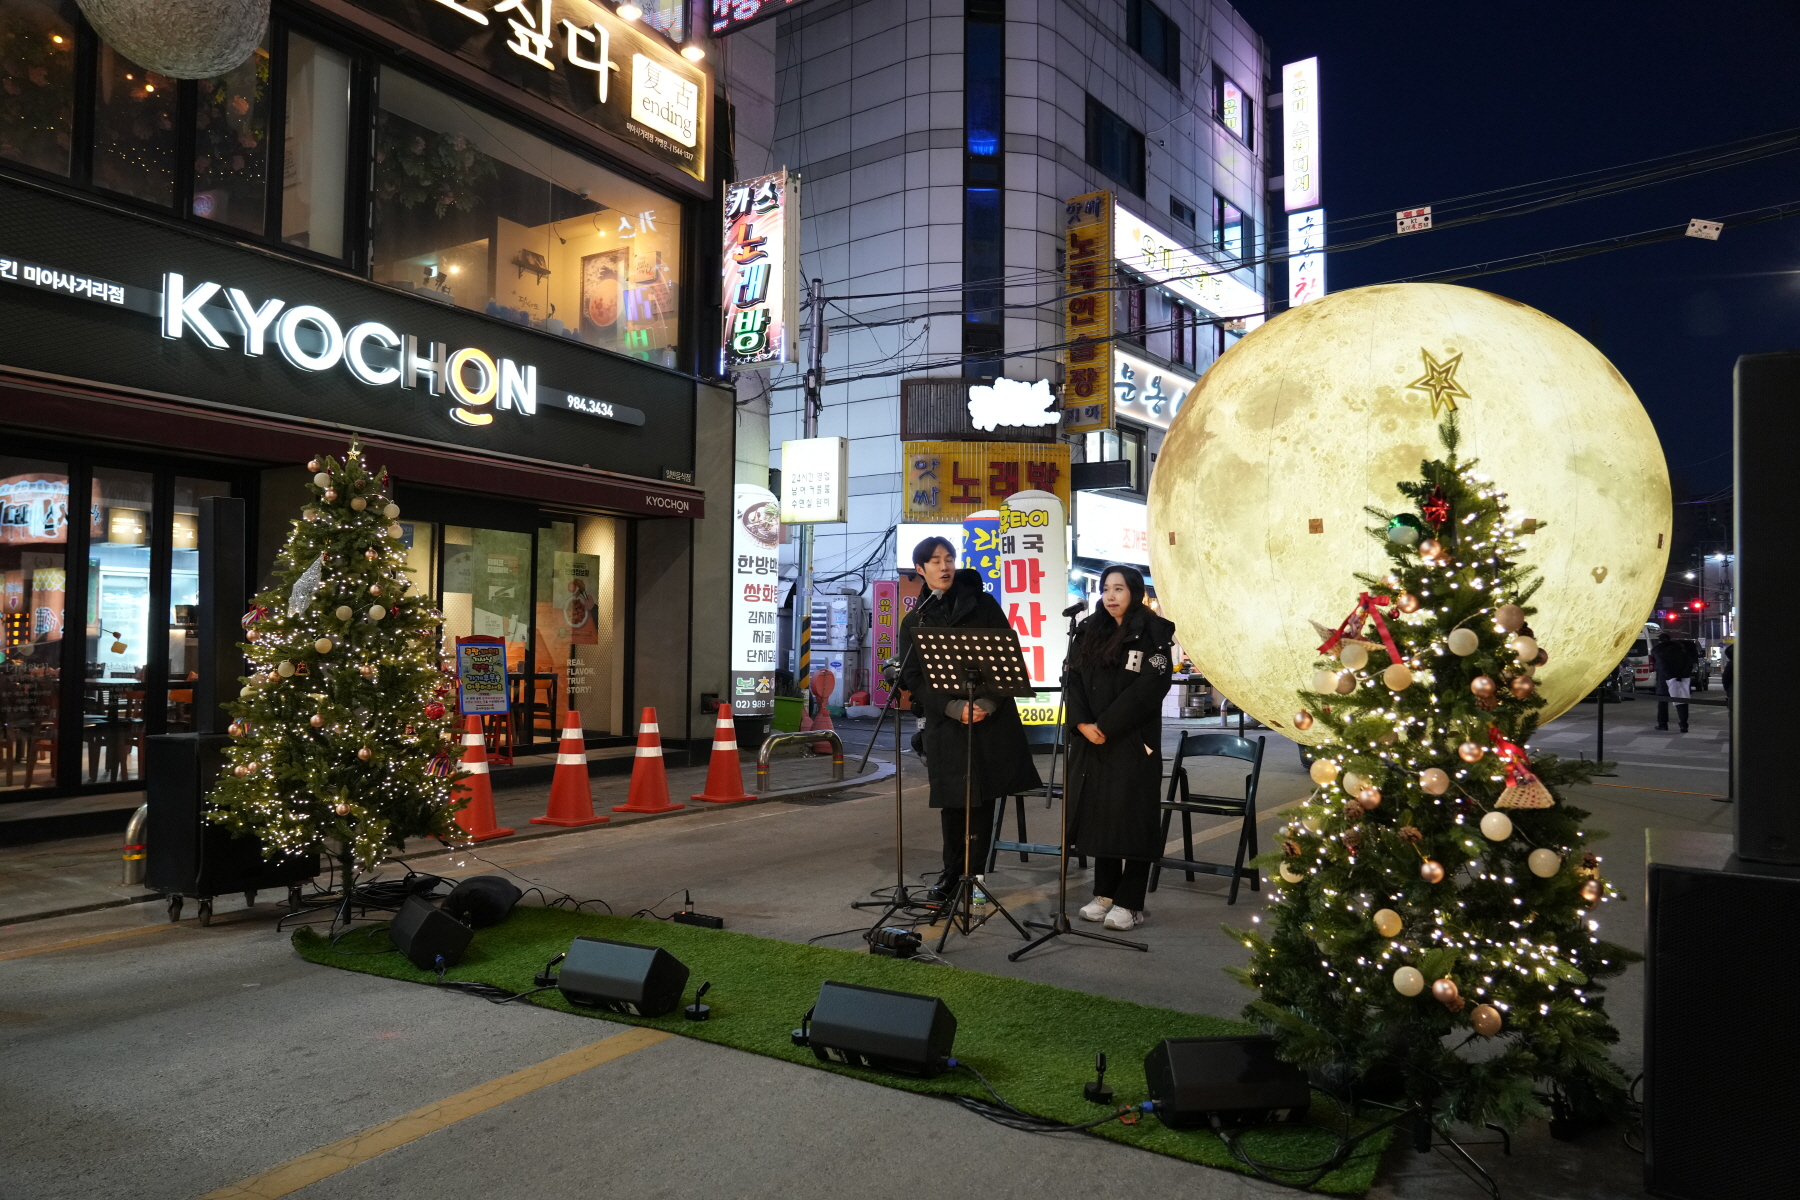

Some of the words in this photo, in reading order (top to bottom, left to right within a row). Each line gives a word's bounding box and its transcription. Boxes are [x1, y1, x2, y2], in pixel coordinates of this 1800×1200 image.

[434, 0, 620, 103] 싶다
[642, 95, 693, 139] ending
[726, 180, 780, 219] 카스
[24, 264, 125, 305] 미아사거리점
[732, 223, 773, 355] 노래방
[161, 272, 537, 425] KYOCHON
[566, 395, 614, 418] 984.3434
[792, 472, 813, 484] 24시간
[950, 460, 1060, 504] 노래방
[646, 496, 690, 514] KYOCHON
[1002, 534, 1045, 554] 태국
[748, 610, 776, 625] 김치찌
[878, 598, 892, 628] 유미
[1004, 558, 1047, 683] 마사지
[566, 658, 585, 667] REAL
[566, 676, 586, 685] TRUE
[566, 685, 592, 694] STORY!
[735, 699, 751, 709] 02)
